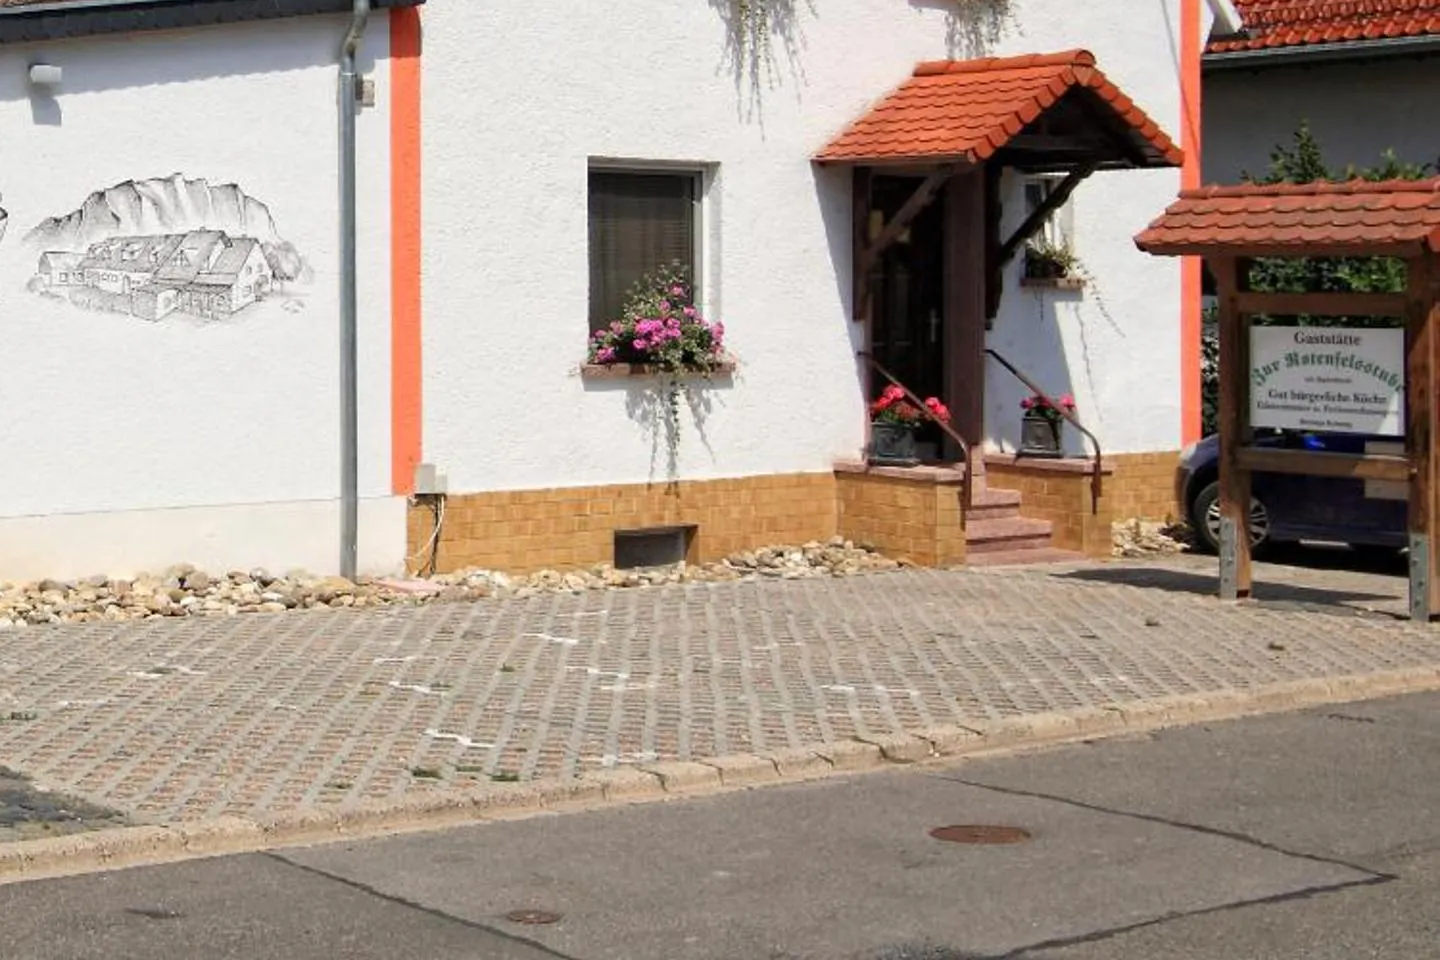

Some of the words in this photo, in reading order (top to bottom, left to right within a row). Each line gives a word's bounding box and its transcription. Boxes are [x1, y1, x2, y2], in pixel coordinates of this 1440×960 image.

[1293, 330, 1361, 346] Gaststätte
[1251, 359, 1281, 387] Zur
[1268, 389, 1288, 400] Gut
